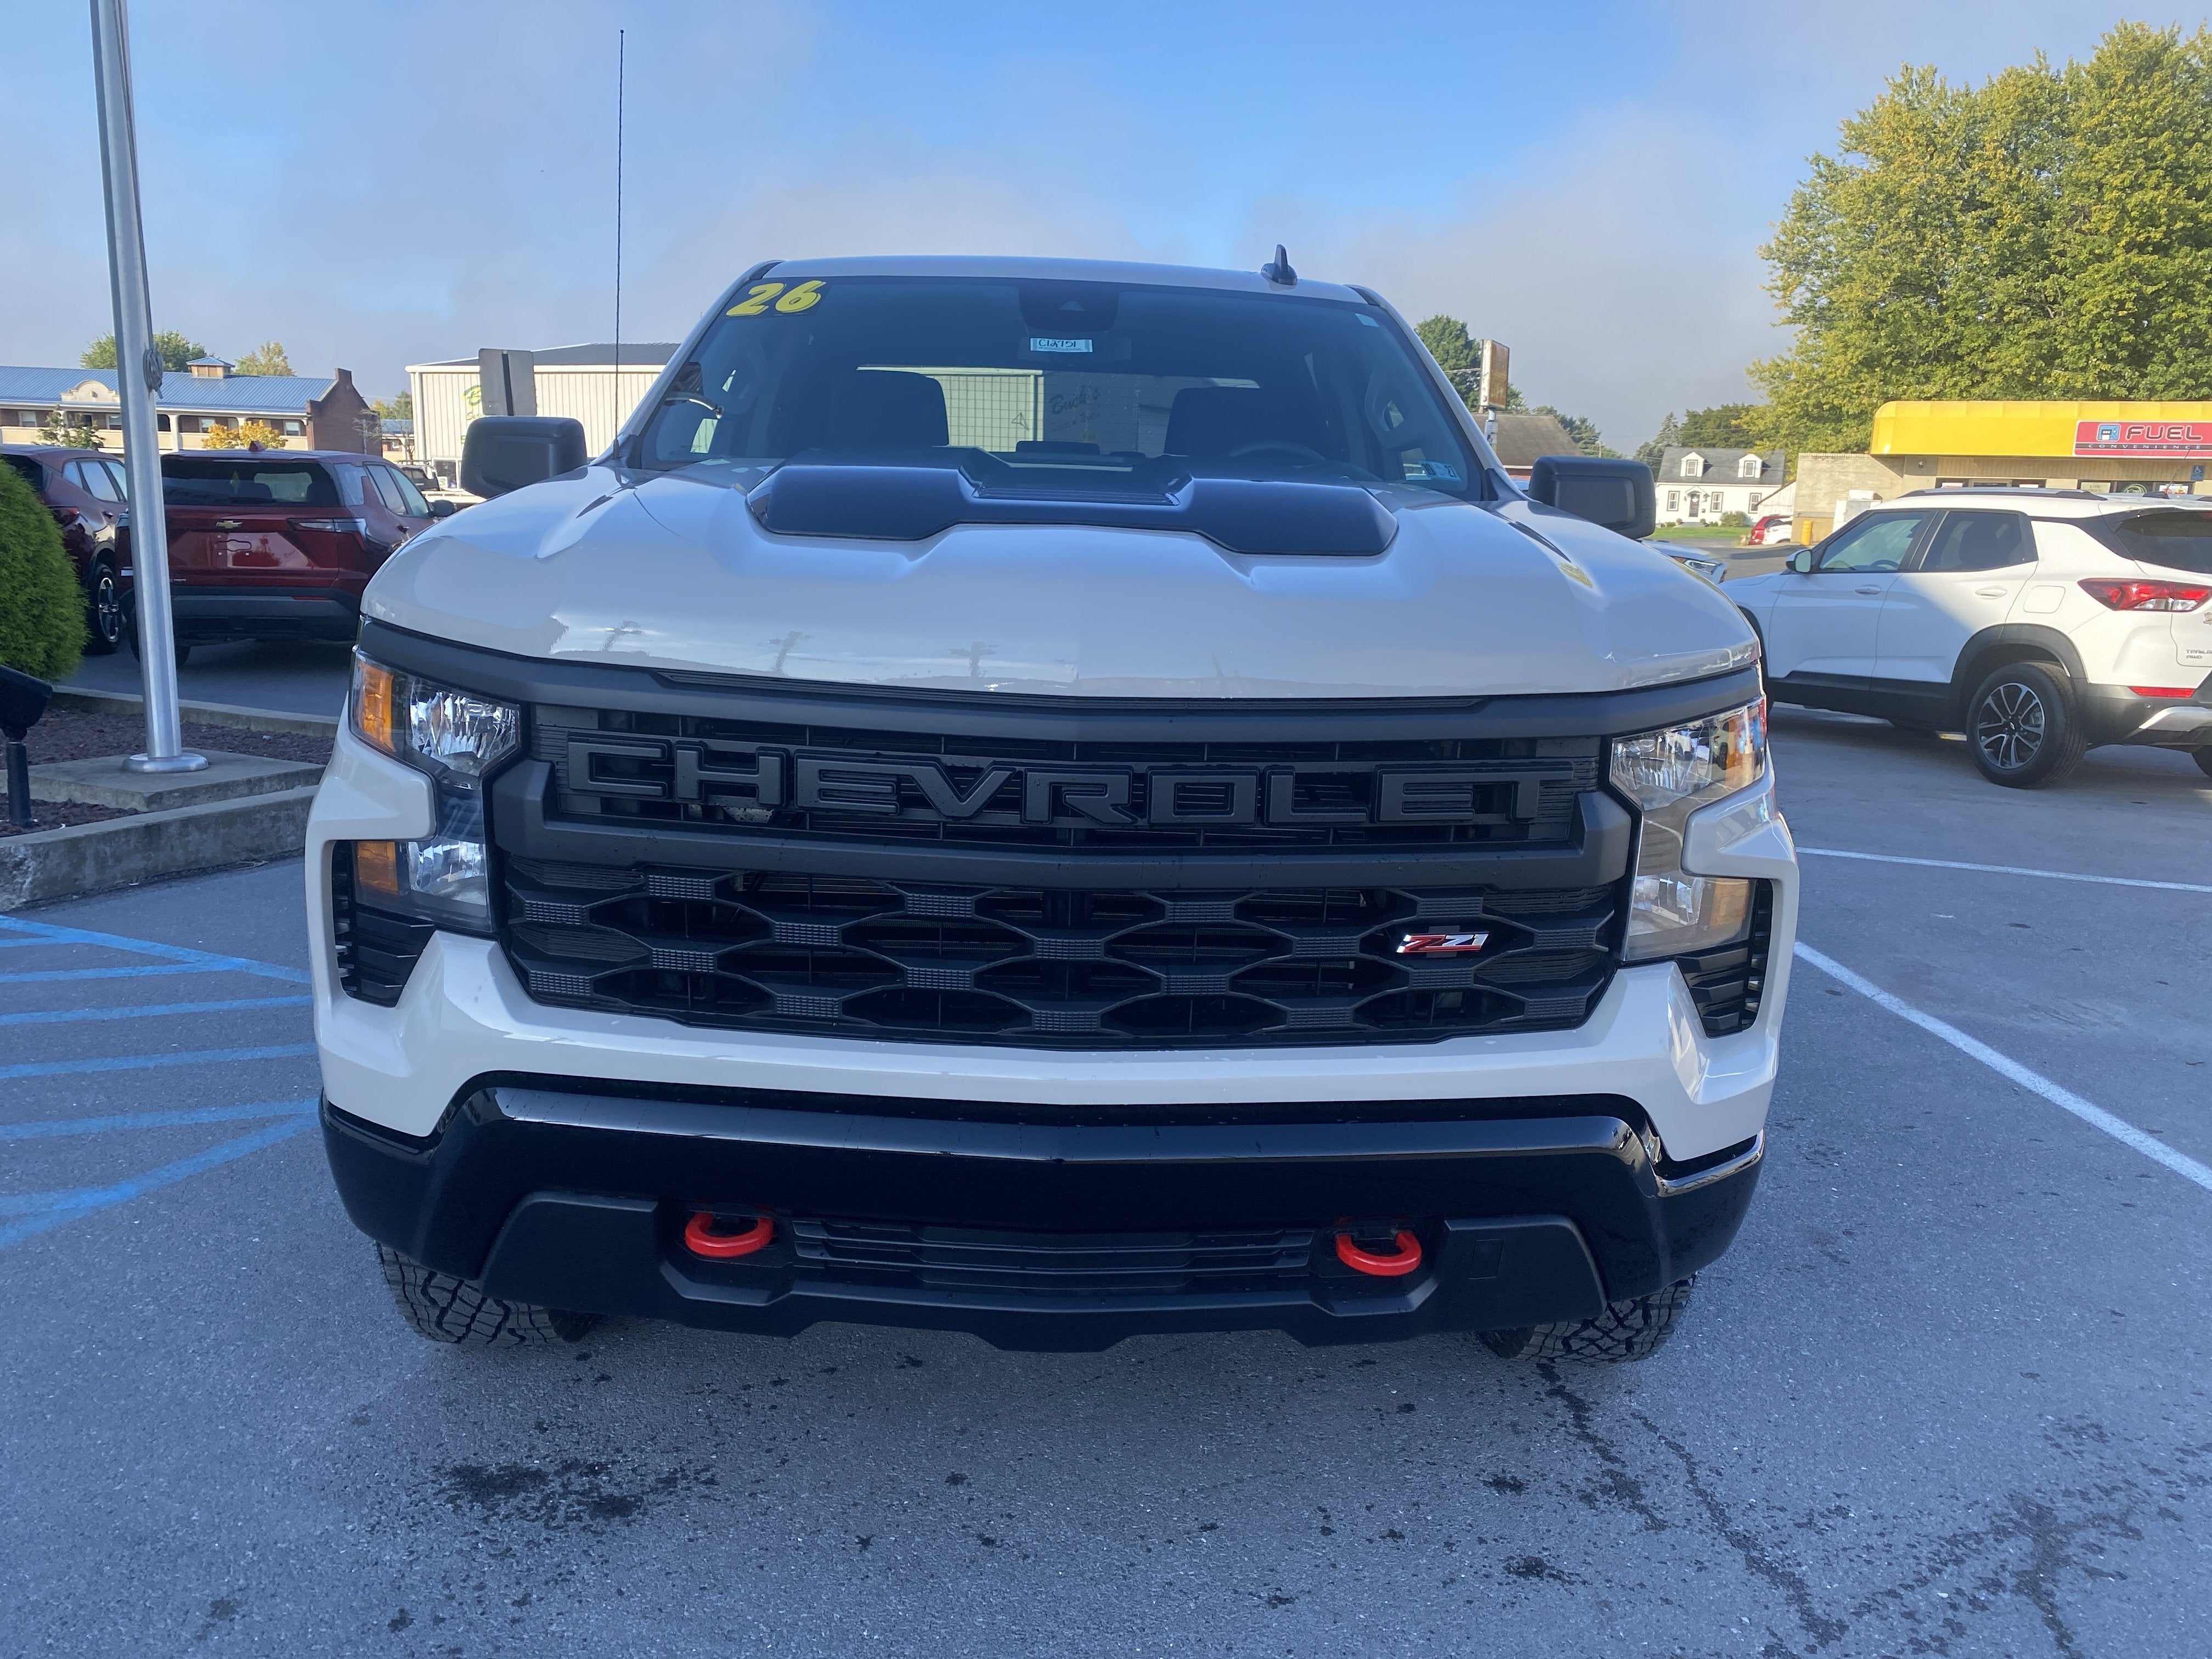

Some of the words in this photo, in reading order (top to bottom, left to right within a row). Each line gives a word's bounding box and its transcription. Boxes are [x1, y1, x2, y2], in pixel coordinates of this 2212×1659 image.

[726, 280, 826, 317] 26
[2125, 425, 2203, 441] FUEL
[567, 738, 1573, 825] CHEVROLET
[1396, 933, 1489, 953] Z71
